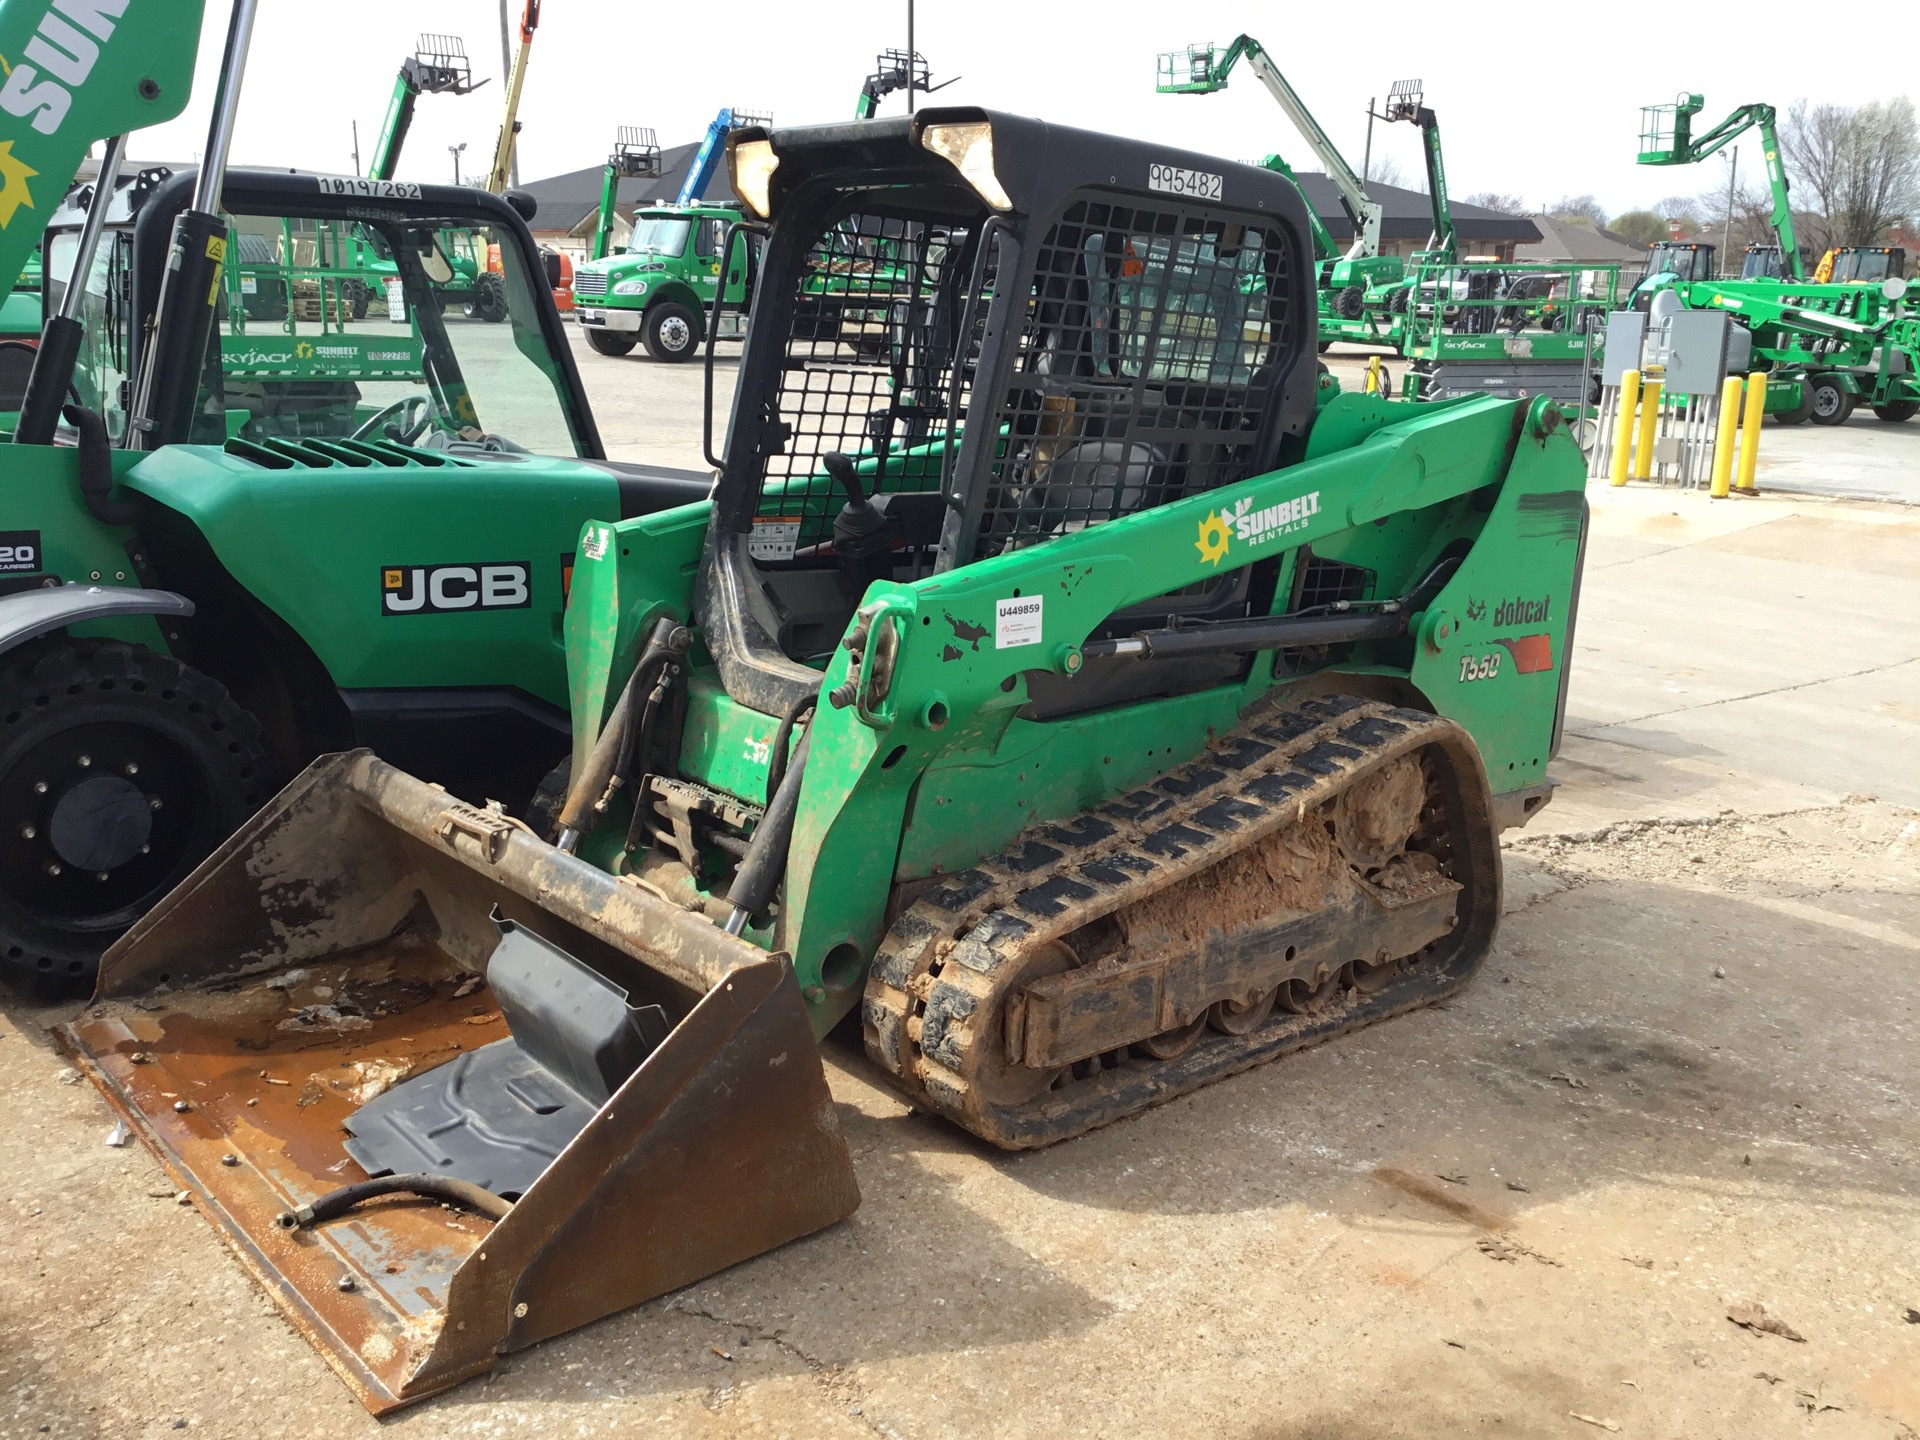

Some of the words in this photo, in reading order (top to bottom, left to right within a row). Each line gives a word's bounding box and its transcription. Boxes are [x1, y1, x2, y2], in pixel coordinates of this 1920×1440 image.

[320, 178, 421, 199] 10197262
[1150, 164, 1222, 199] 995482
[315, 346, 360, 356] SUNBELT
[1444, 339, 1486, 350] SKYJACK
[1236, 491, 1320, 541] SUNBELT
[1249, 518, 1309, 547] RENTALS
[385, 565, 528, 612] JCB
[999, 603, 1040, 618] U449859
